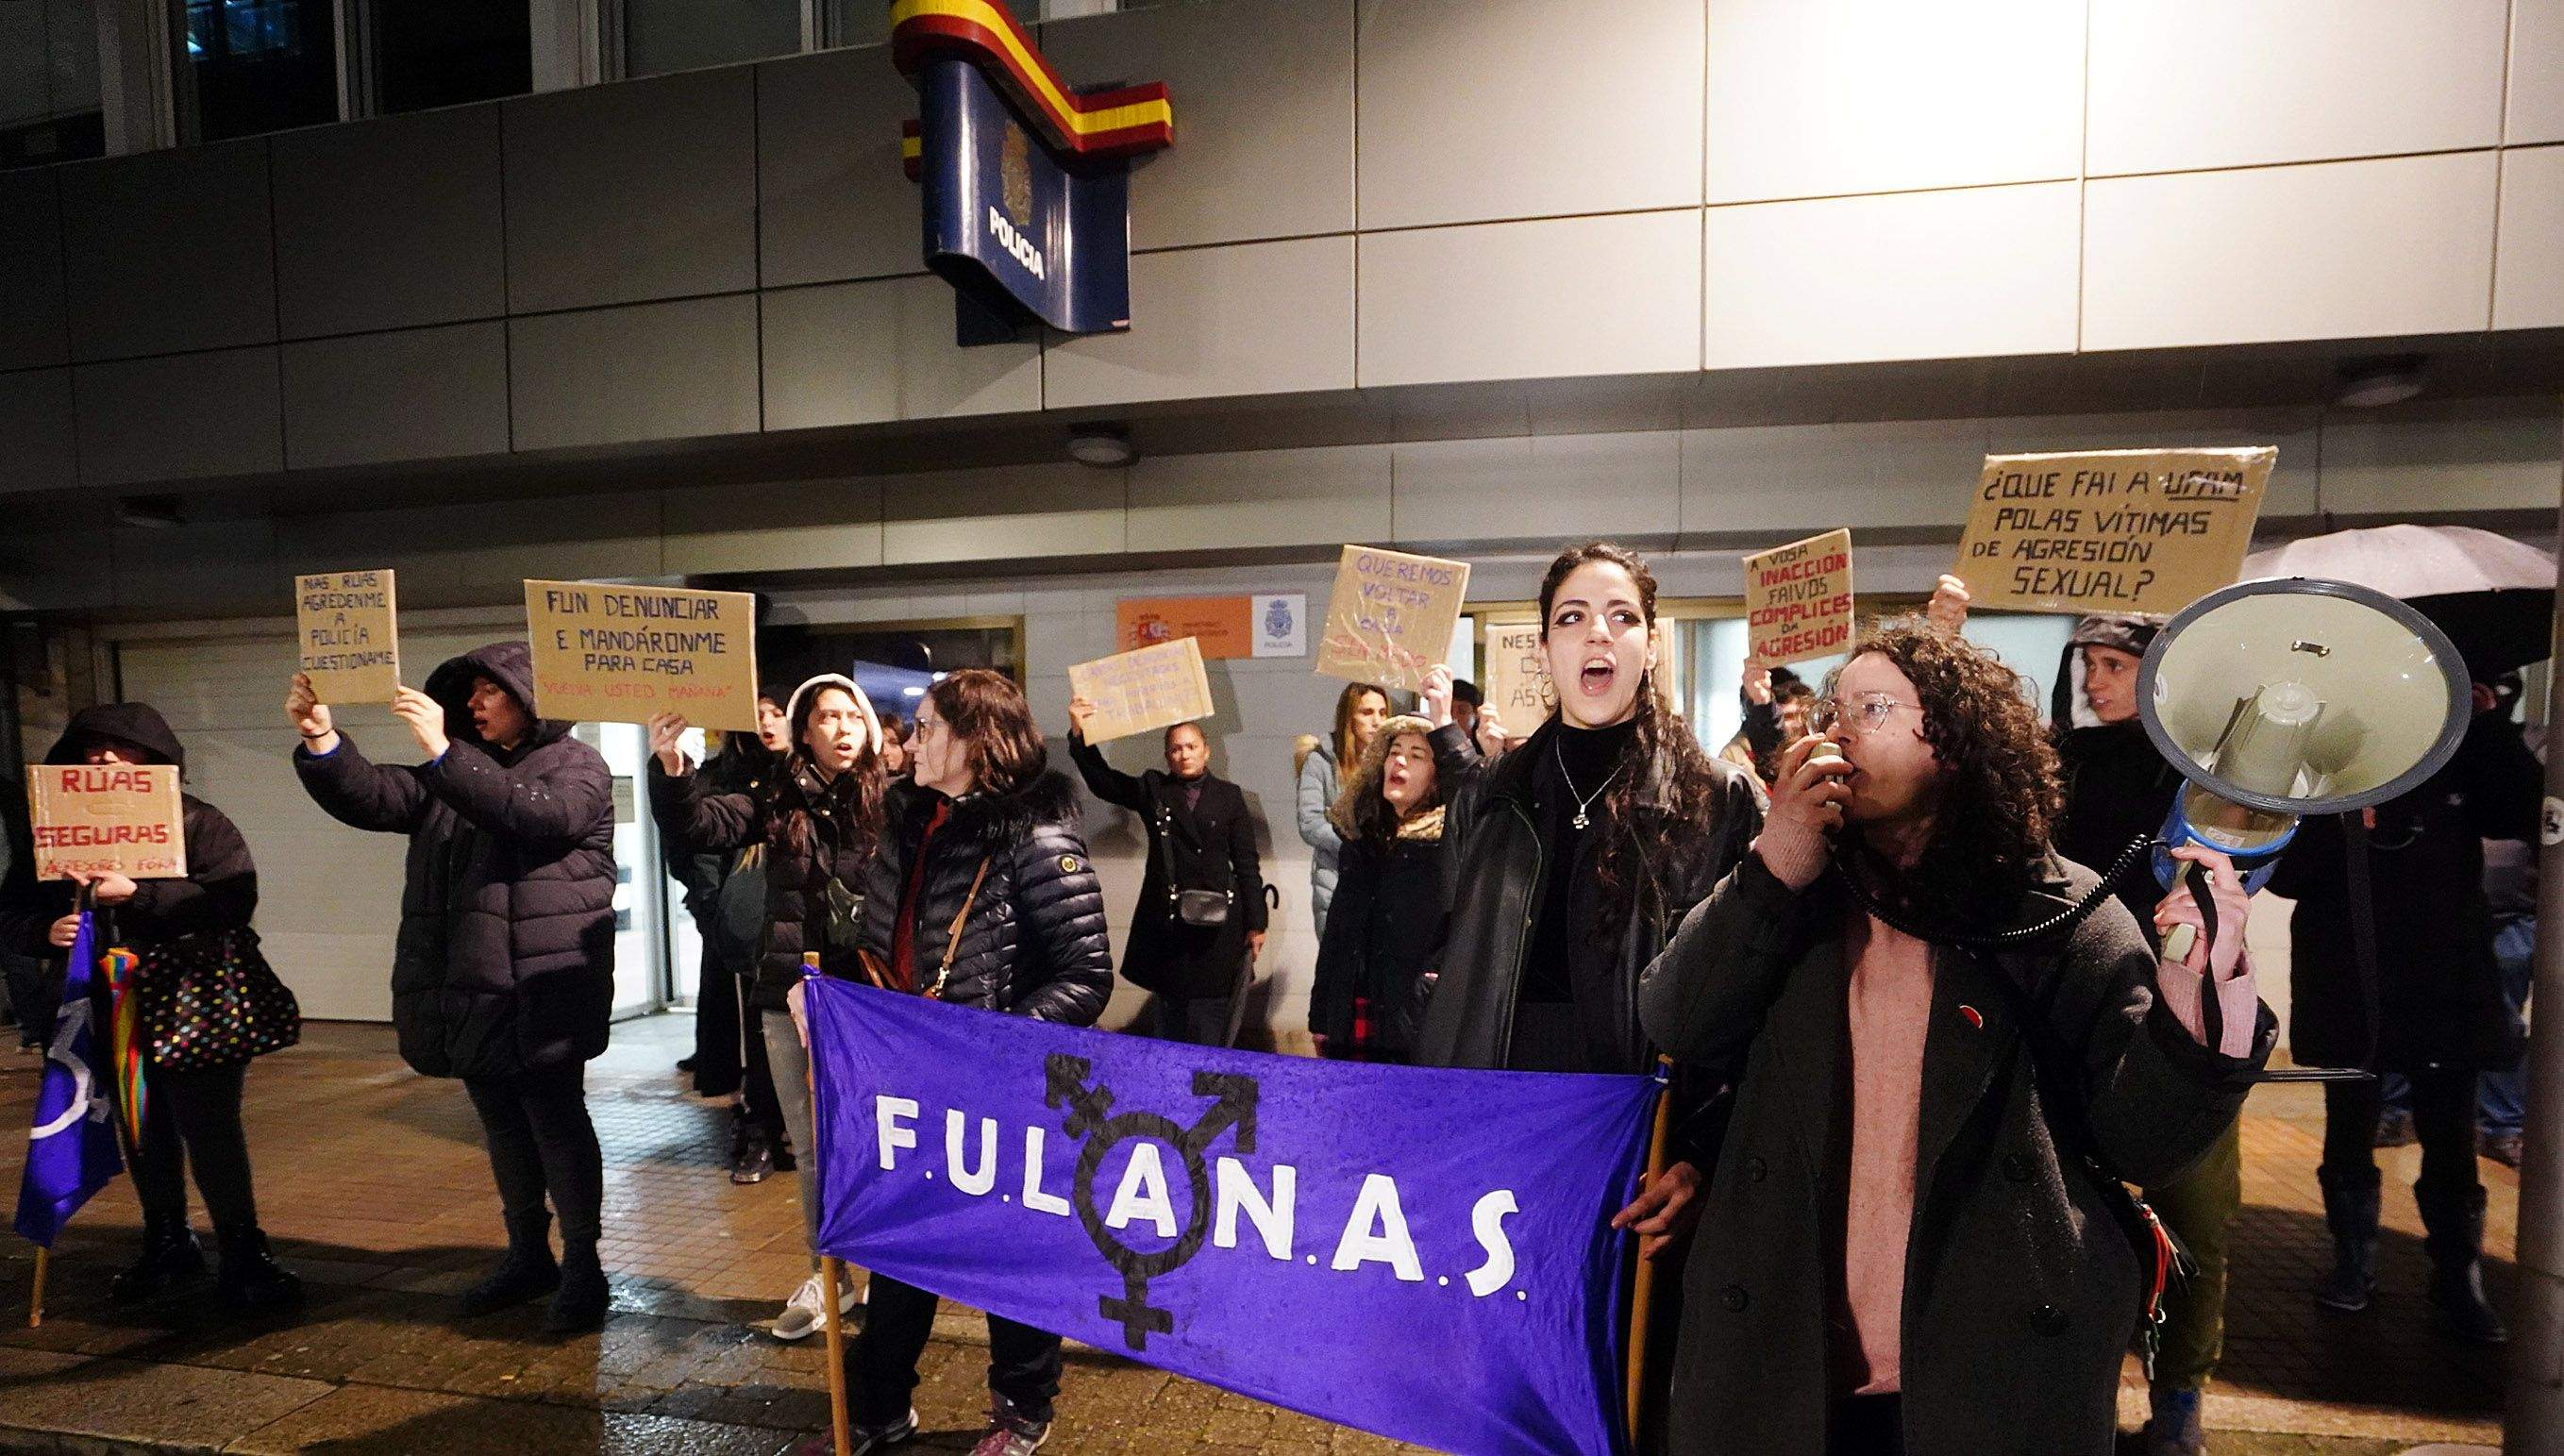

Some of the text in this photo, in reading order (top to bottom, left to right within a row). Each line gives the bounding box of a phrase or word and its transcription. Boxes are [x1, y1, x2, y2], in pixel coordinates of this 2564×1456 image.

[989, 206, 1045, 280] POLICIA
[1984, 470, 2244, 501] ¿QUE FAI A UFAM
[1993, 504, 2212, 536] POLAS VÍTIMAS
[1750, 544, 1808, 573] A VOSA
[1971, 535, 2153, 563] DE AGRESIÓN
[1357, 554, 1452, 586] QUEREMOS
[2010, 566, 2155, 601] SEXUAL?
[302, 593, 387, 611] AGREDENME
[546, 590, 720, 620] FUN DENUNCIAR
[1364, 581, 1431, 609] VOLTAR
[1768, 577, 1829, 605] FAIVOS
[334, 611, 345, 628] A
[310, 623, 371, 647] POLICÍA
[556, 626, 727, 654] E MANDÁRONME
[584, 653, 694, 675] PARA CASA
[603, 681, 656, 699] USTED
[34, 823, 168, 848] SEGURAS
